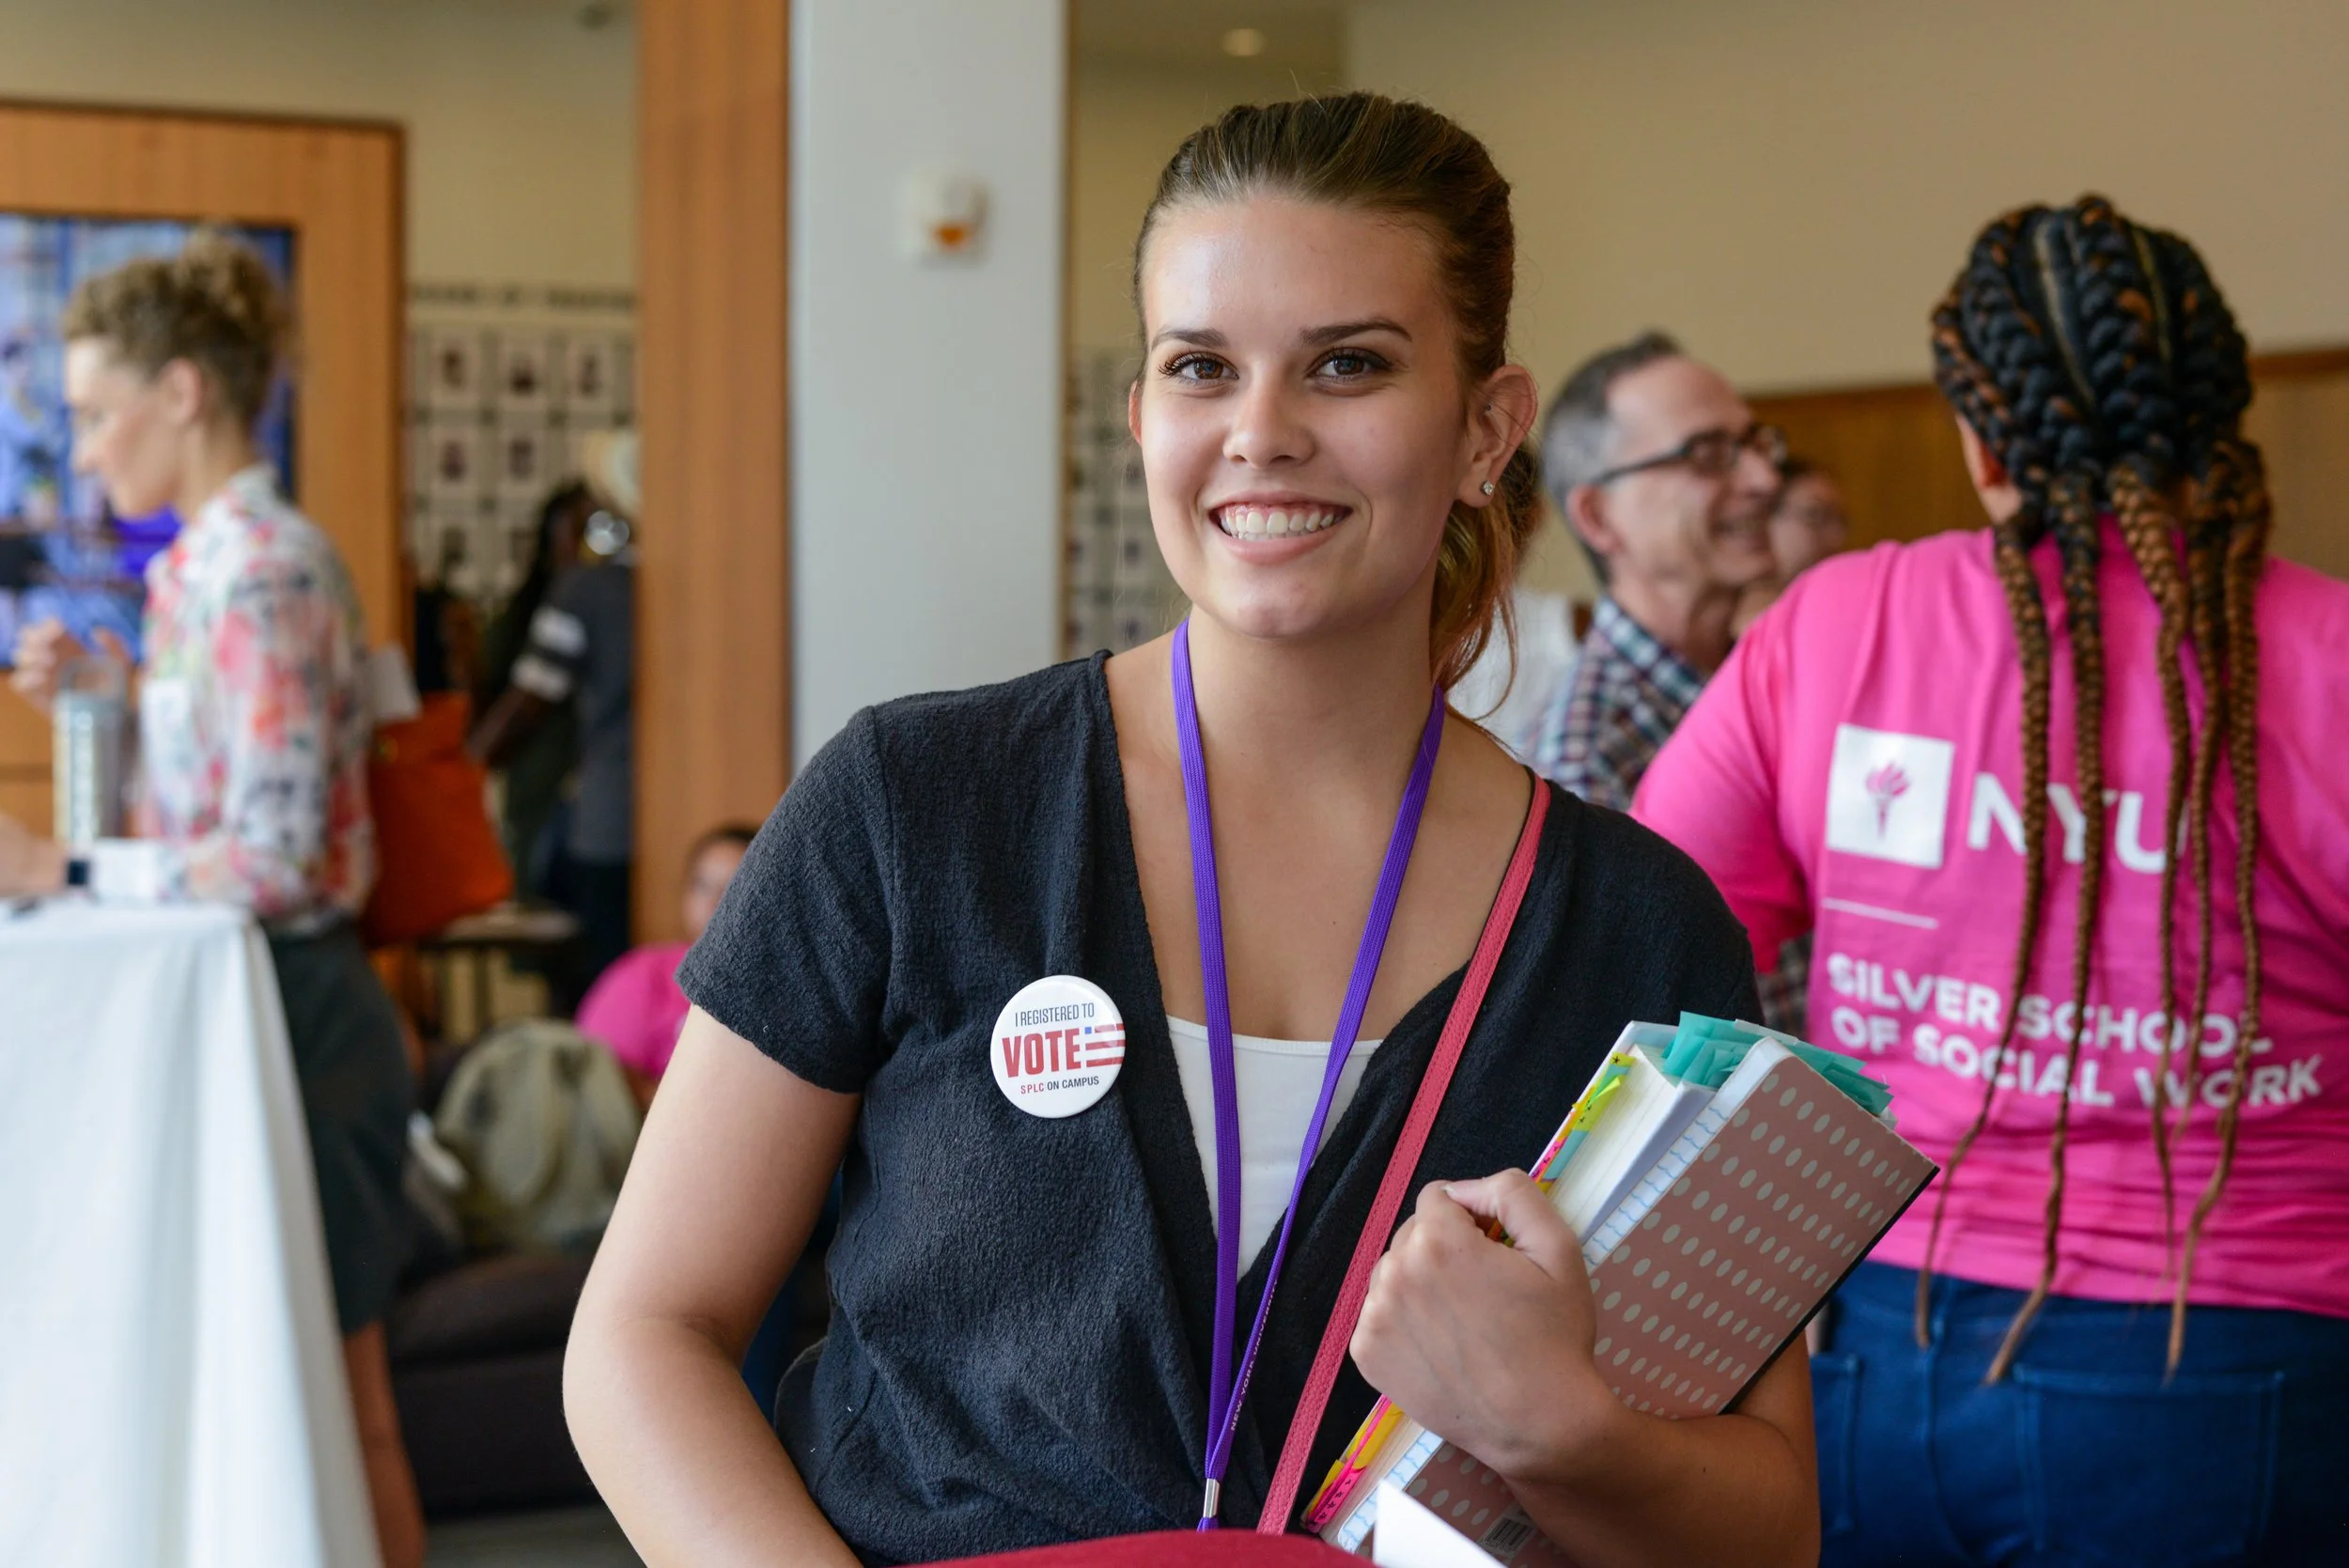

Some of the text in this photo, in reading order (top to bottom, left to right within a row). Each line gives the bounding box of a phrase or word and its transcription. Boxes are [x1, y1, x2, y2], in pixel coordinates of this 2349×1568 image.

[1967, 771, 2189, 876] NYU
[1015, 1002, 1095, 1028] I REGISTERED TO
[1827, 951, 2001, 1032] SILVER
[1002, 1028, 1081, 1079] VOTE
[1020, 1076, 1099, 1094] SPLC ON CAMPUS
[1831, 1005, 1900, 1054] OF
[1912, 1022, 2113, 1107] SOCIAL
[1230, 1399, 1243, 1431] NEW
[1241, 1359, 1255, 1396] YORK
